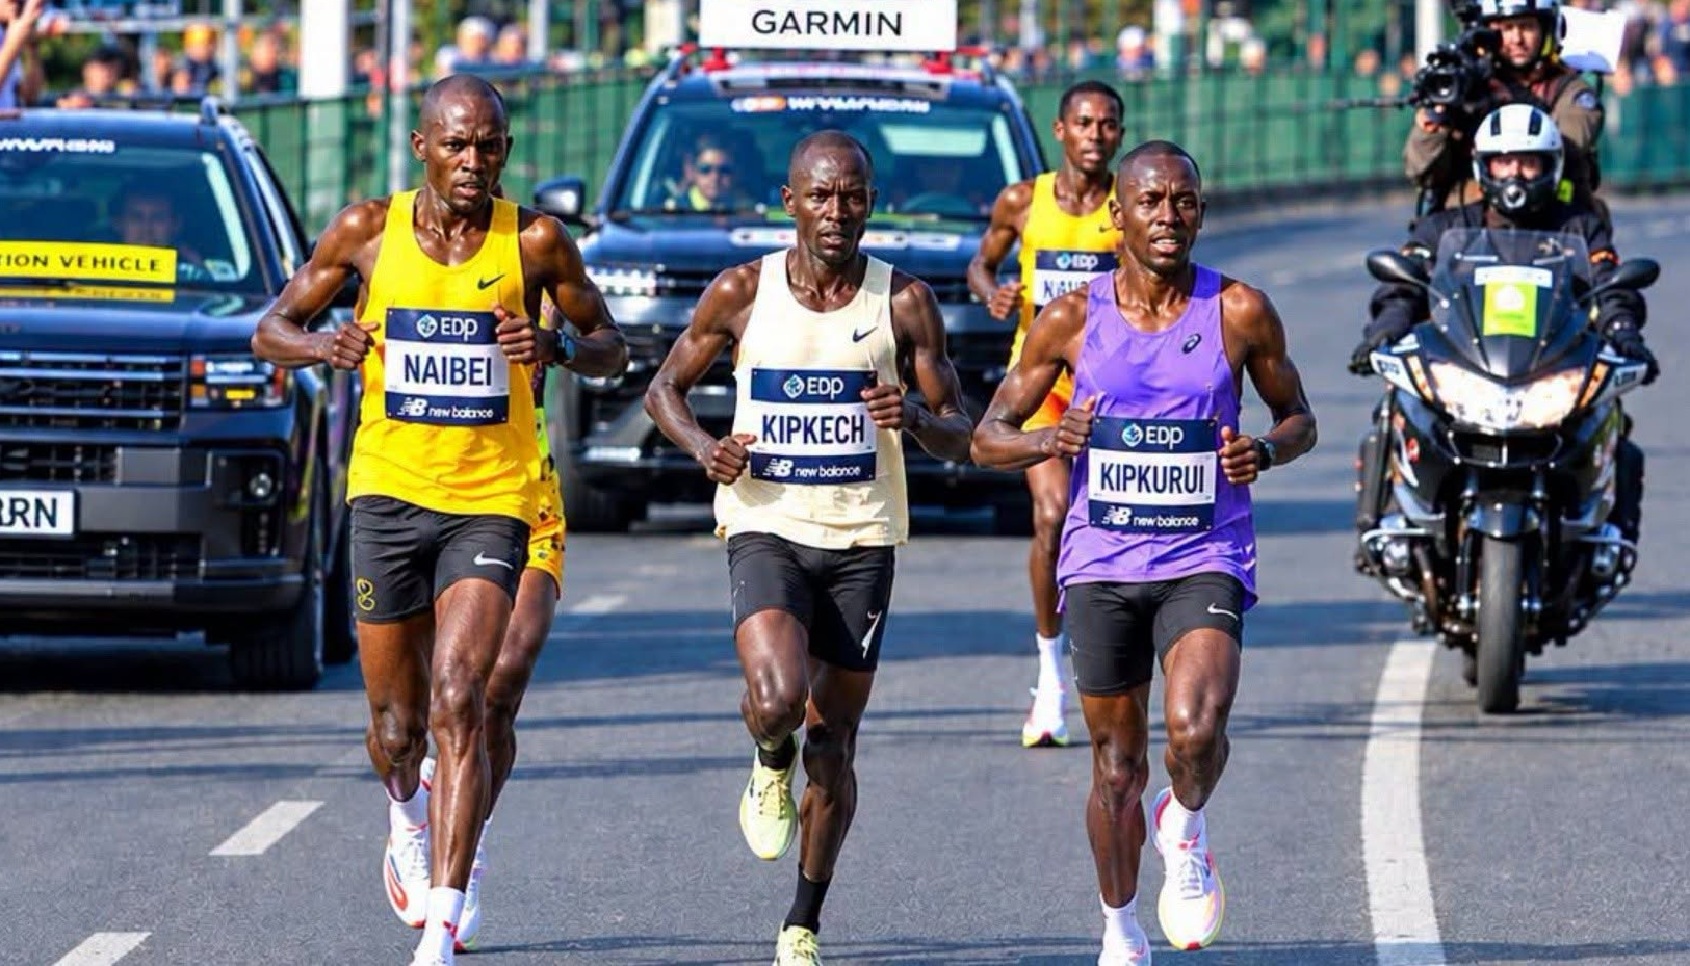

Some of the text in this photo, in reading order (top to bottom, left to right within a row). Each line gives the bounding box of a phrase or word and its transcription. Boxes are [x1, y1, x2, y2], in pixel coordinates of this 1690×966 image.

[752, 10, 902, 36] GARMIN
[60, 256, 161, 272] VEHICLE
[404, 354, 492, 386] NAIBEI
[762, 414, 864, 444] KIPKECH
[819, 464, 860, 477] balance
[1101, 462, 1204, 494] KIPKURUI
[0, 497, 57, 528] RN
[1157, 514, 1199, 527] balance
